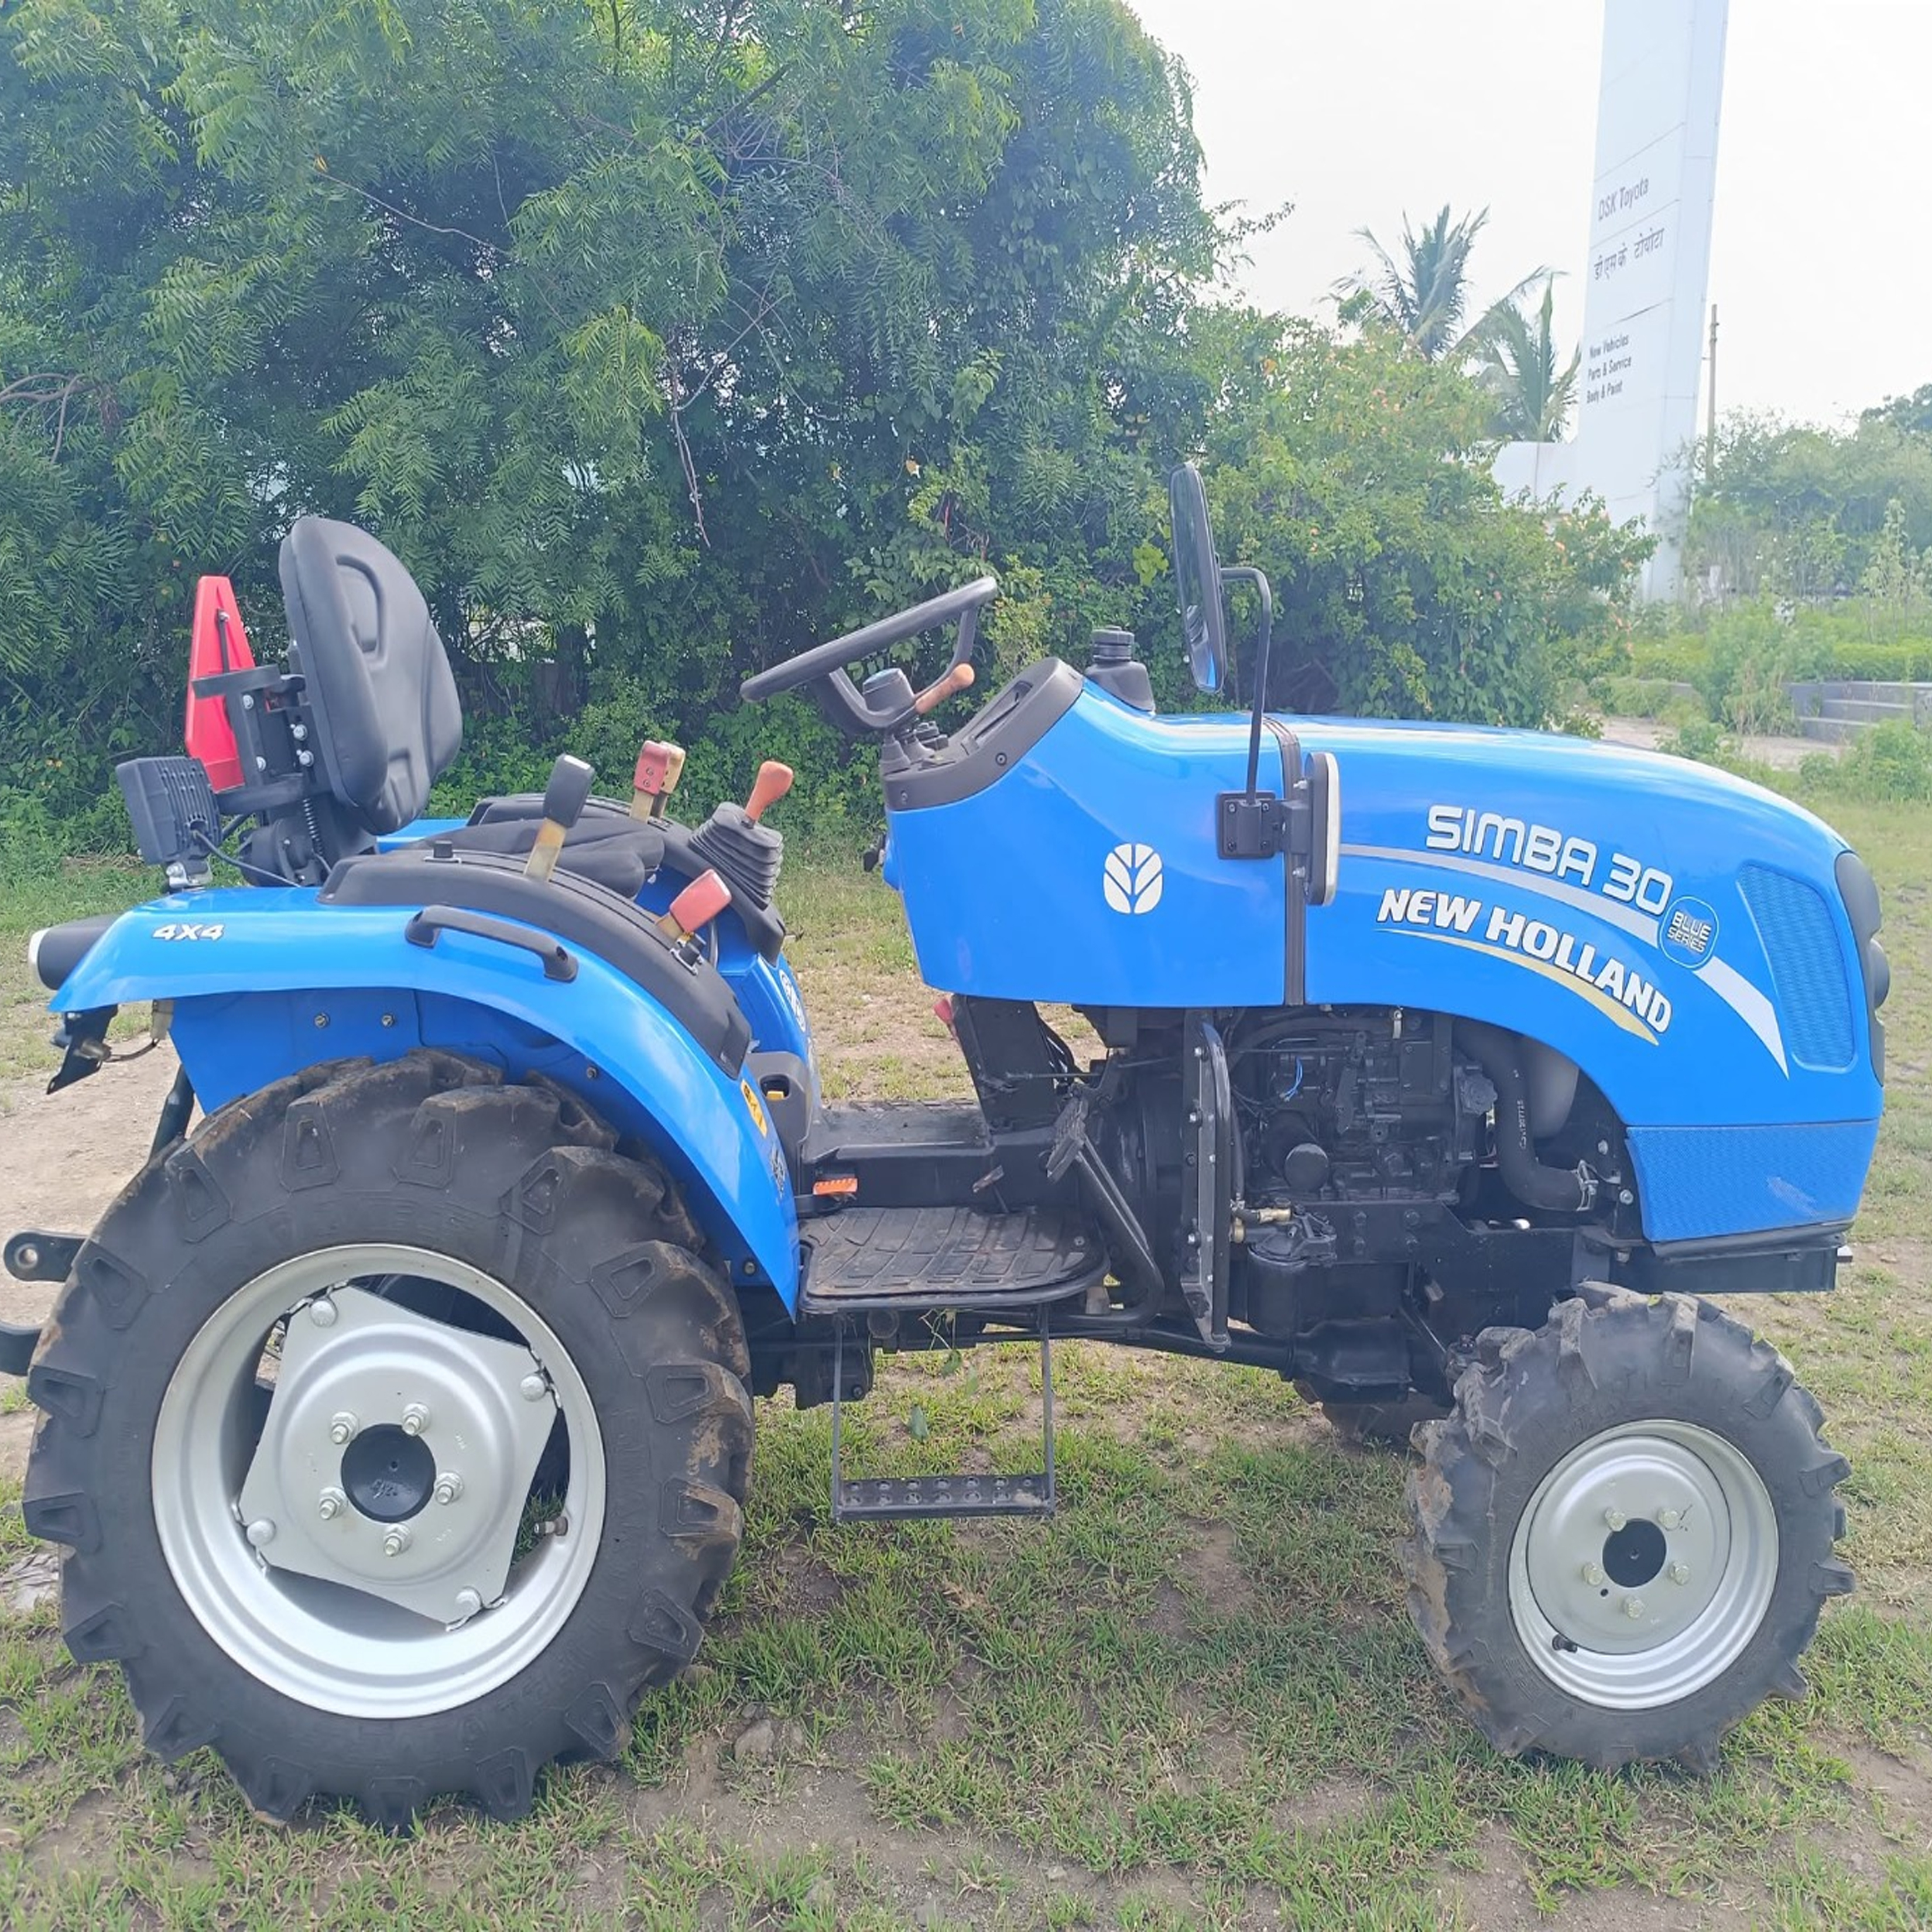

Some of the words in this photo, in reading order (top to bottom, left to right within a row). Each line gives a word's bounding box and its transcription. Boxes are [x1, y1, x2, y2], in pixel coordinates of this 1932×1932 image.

[1598, 191, 1618, 221] DSK
[1619, 177, 1649, 209] Toyota
[1589, 345, 1601, 358] New
[1604, 334, 1629, 354] Vehicles
[1588, 368, 1601, 382] Parts
[1609, 355, 1632, 374] Service
[1426, 804, 1598, 886] SIMBA
[1602, 852, 1674, 916] 30
[1667, 926, 1707, 954] SERIES
[1671, 910, 1712, 941] BLUE
[1376, 889, 1482, 933] NEW
[1485, 906, 1673, 1034] HOLLAND
